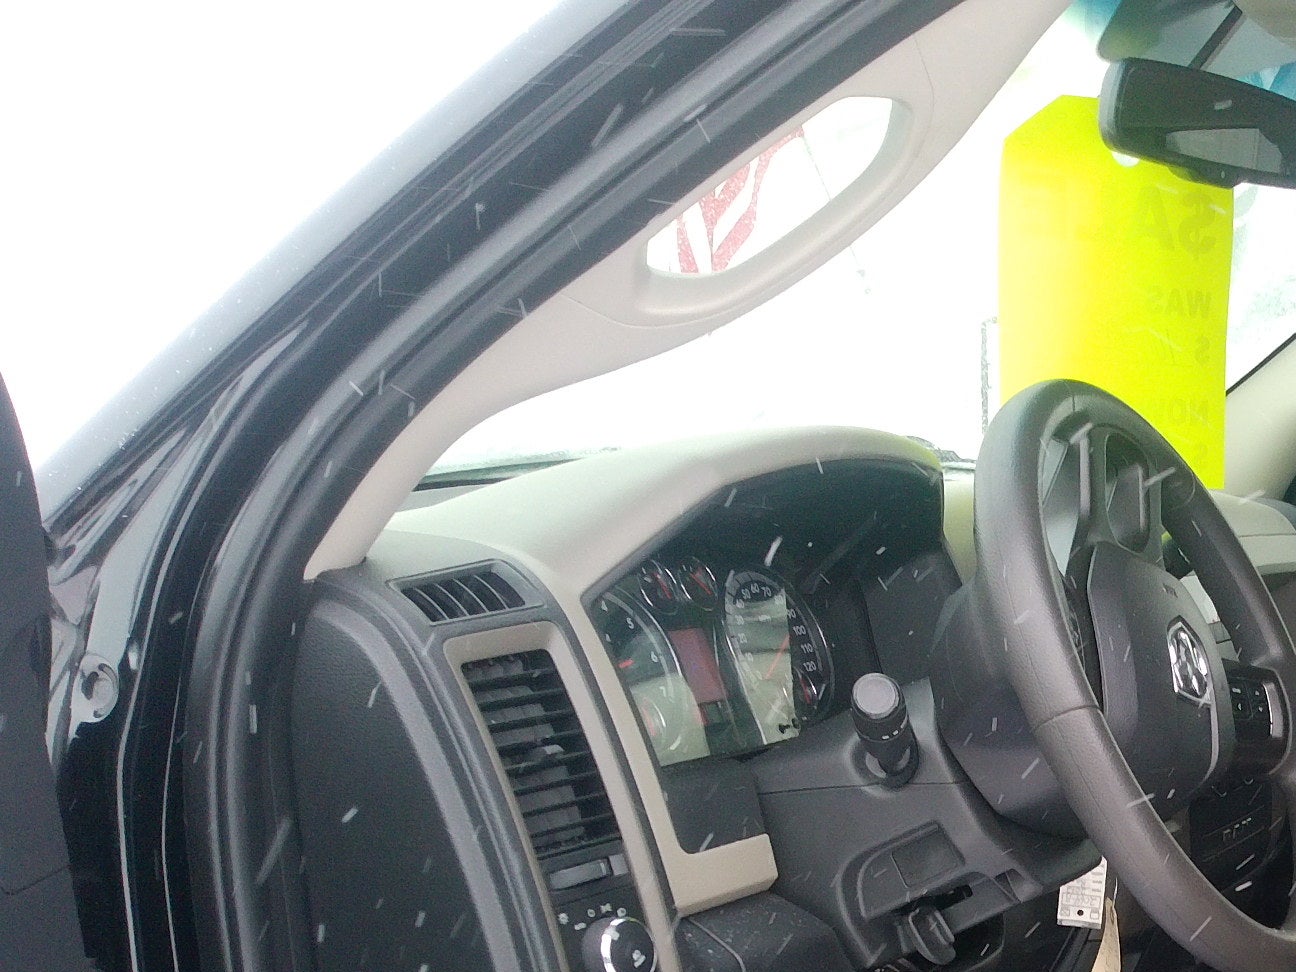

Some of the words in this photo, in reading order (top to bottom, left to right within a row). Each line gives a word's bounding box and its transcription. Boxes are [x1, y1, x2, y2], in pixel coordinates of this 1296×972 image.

[761, 586, 772, 598] 70
[793, 625, 807, 637] 100
[801, 642, 814, 654] 110
[803, 661, 817, 672] 120
